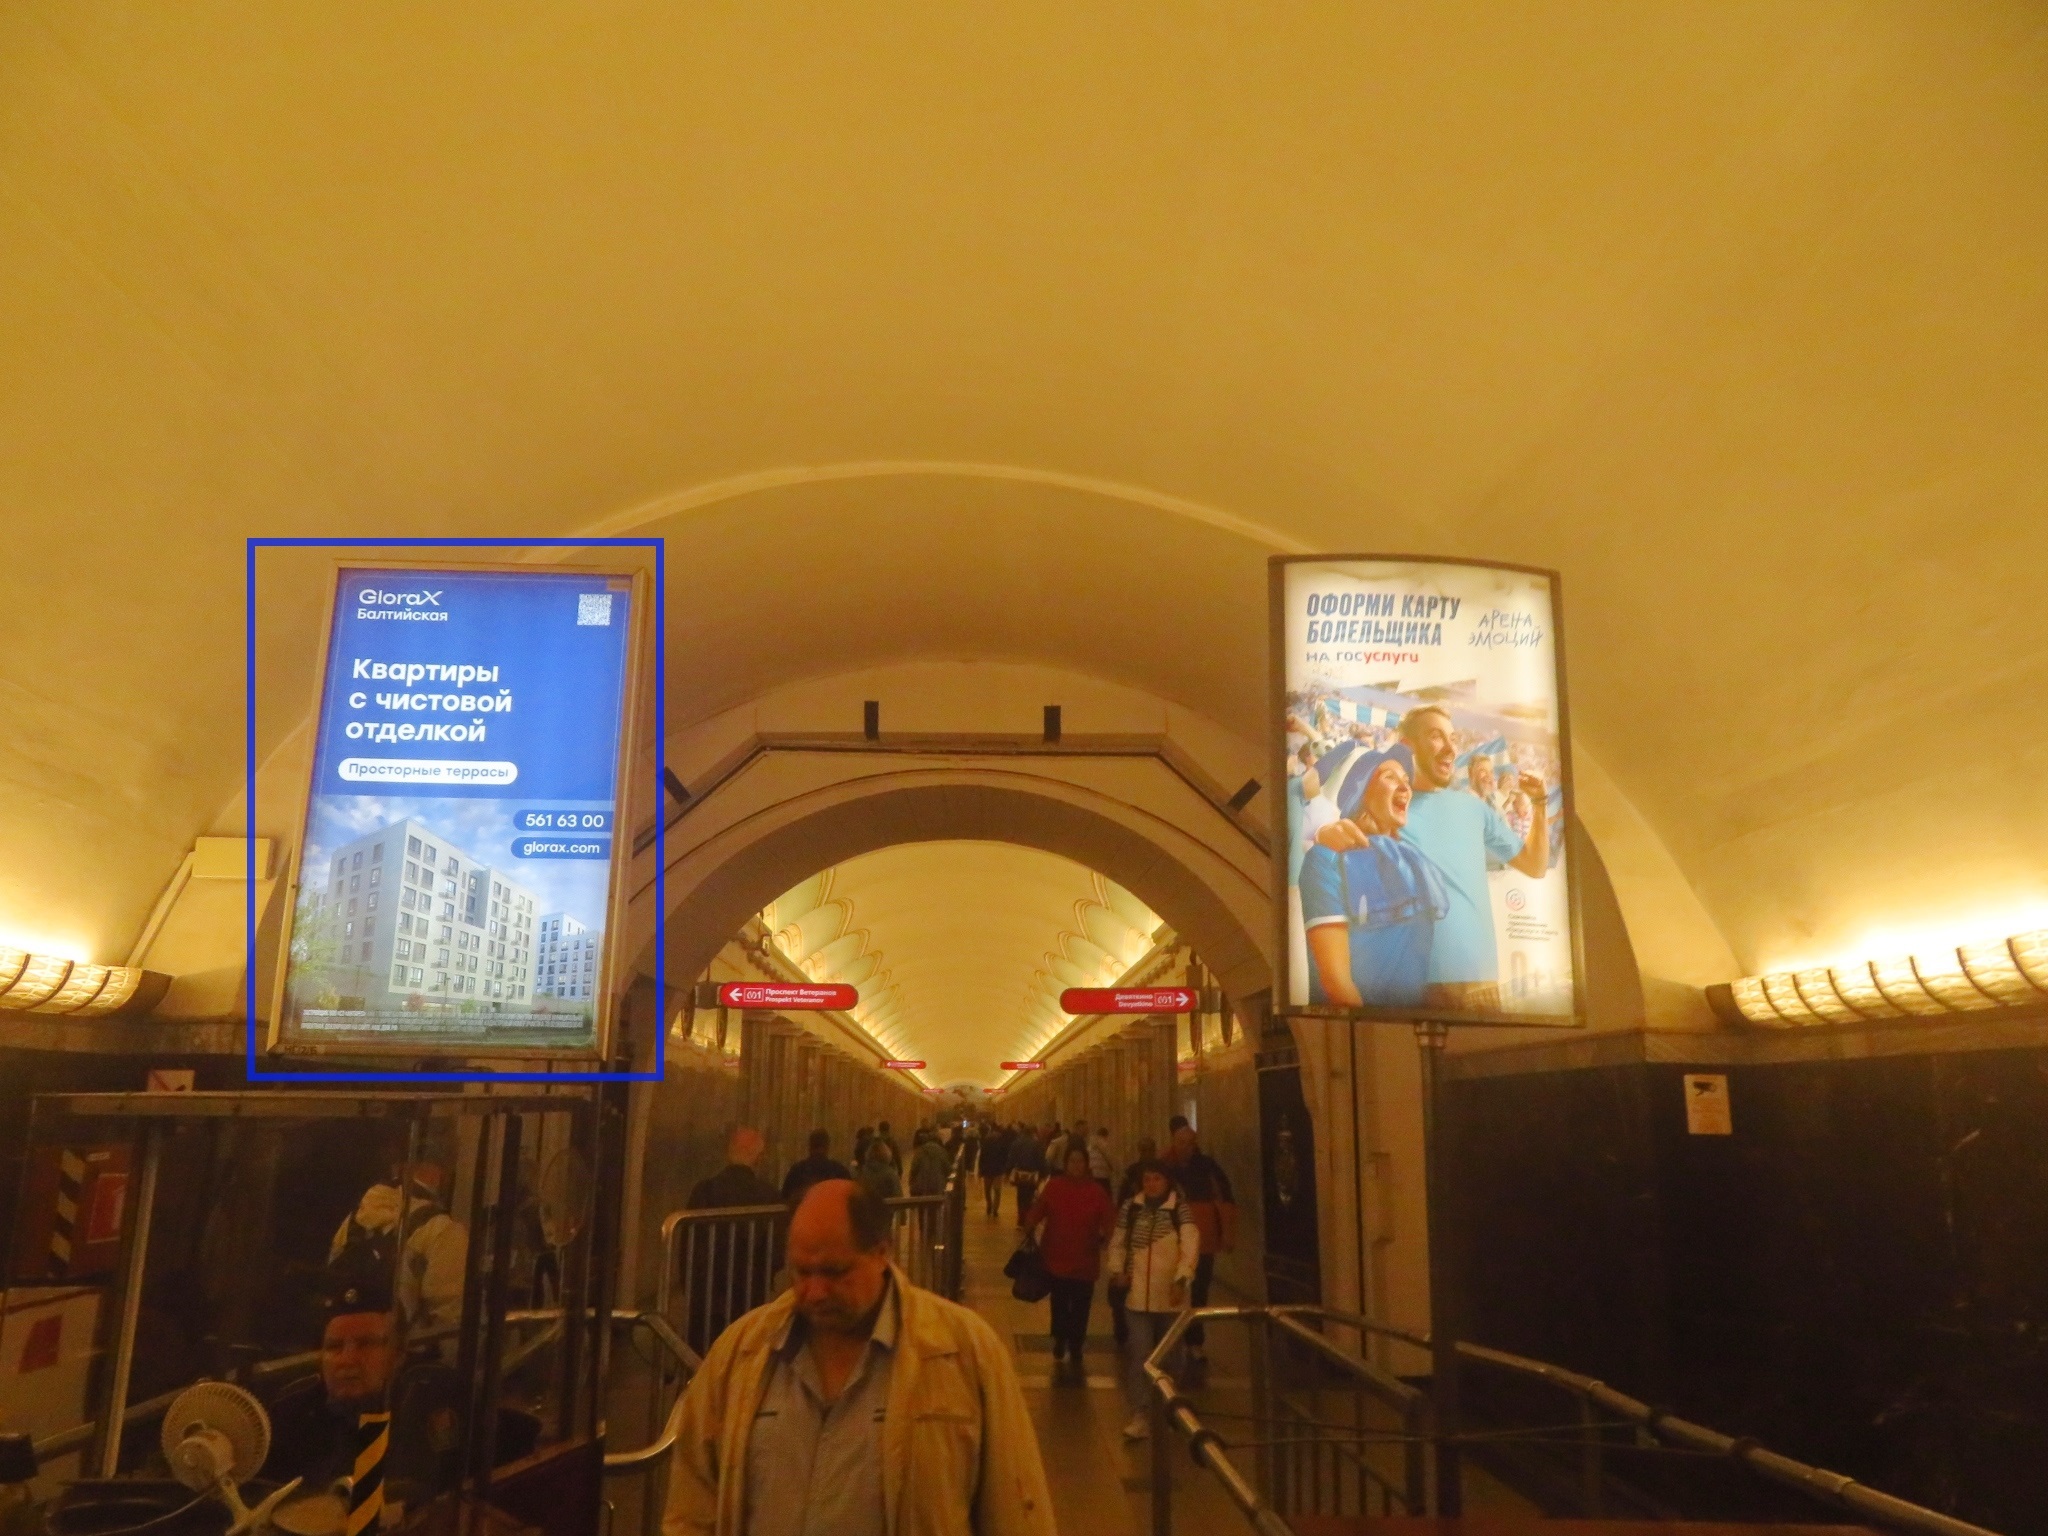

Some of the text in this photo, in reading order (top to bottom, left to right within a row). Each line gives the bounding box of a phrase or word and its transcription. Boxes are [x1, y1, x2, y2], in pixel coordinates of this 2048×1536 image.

[359, 589, 443, 606] GloraX
[1306, 593, 1461, 620] ОФОРМИ КАРТУ
[357, 608, 448, 621] Балтийская
[1478, 608, 1532, 630] АРЕНА
[1306, 620, 1442, 646] БОЛЕЛЬЩИКА
[1468, 625, 1544, 650] ЭМОЦИЙ
[1336, 651, 1419, 665] госуслуги
[353, 658, 499, 688] Квартиры
[349, 689, 512, 712] с чистовой
[345, 718, 486, 743] отделкой
[348, 763, 509, 779] Просторные террасы
[525, 814, 604, 828] 561 63 00
[523, 841, 600, 856] glorax.com
